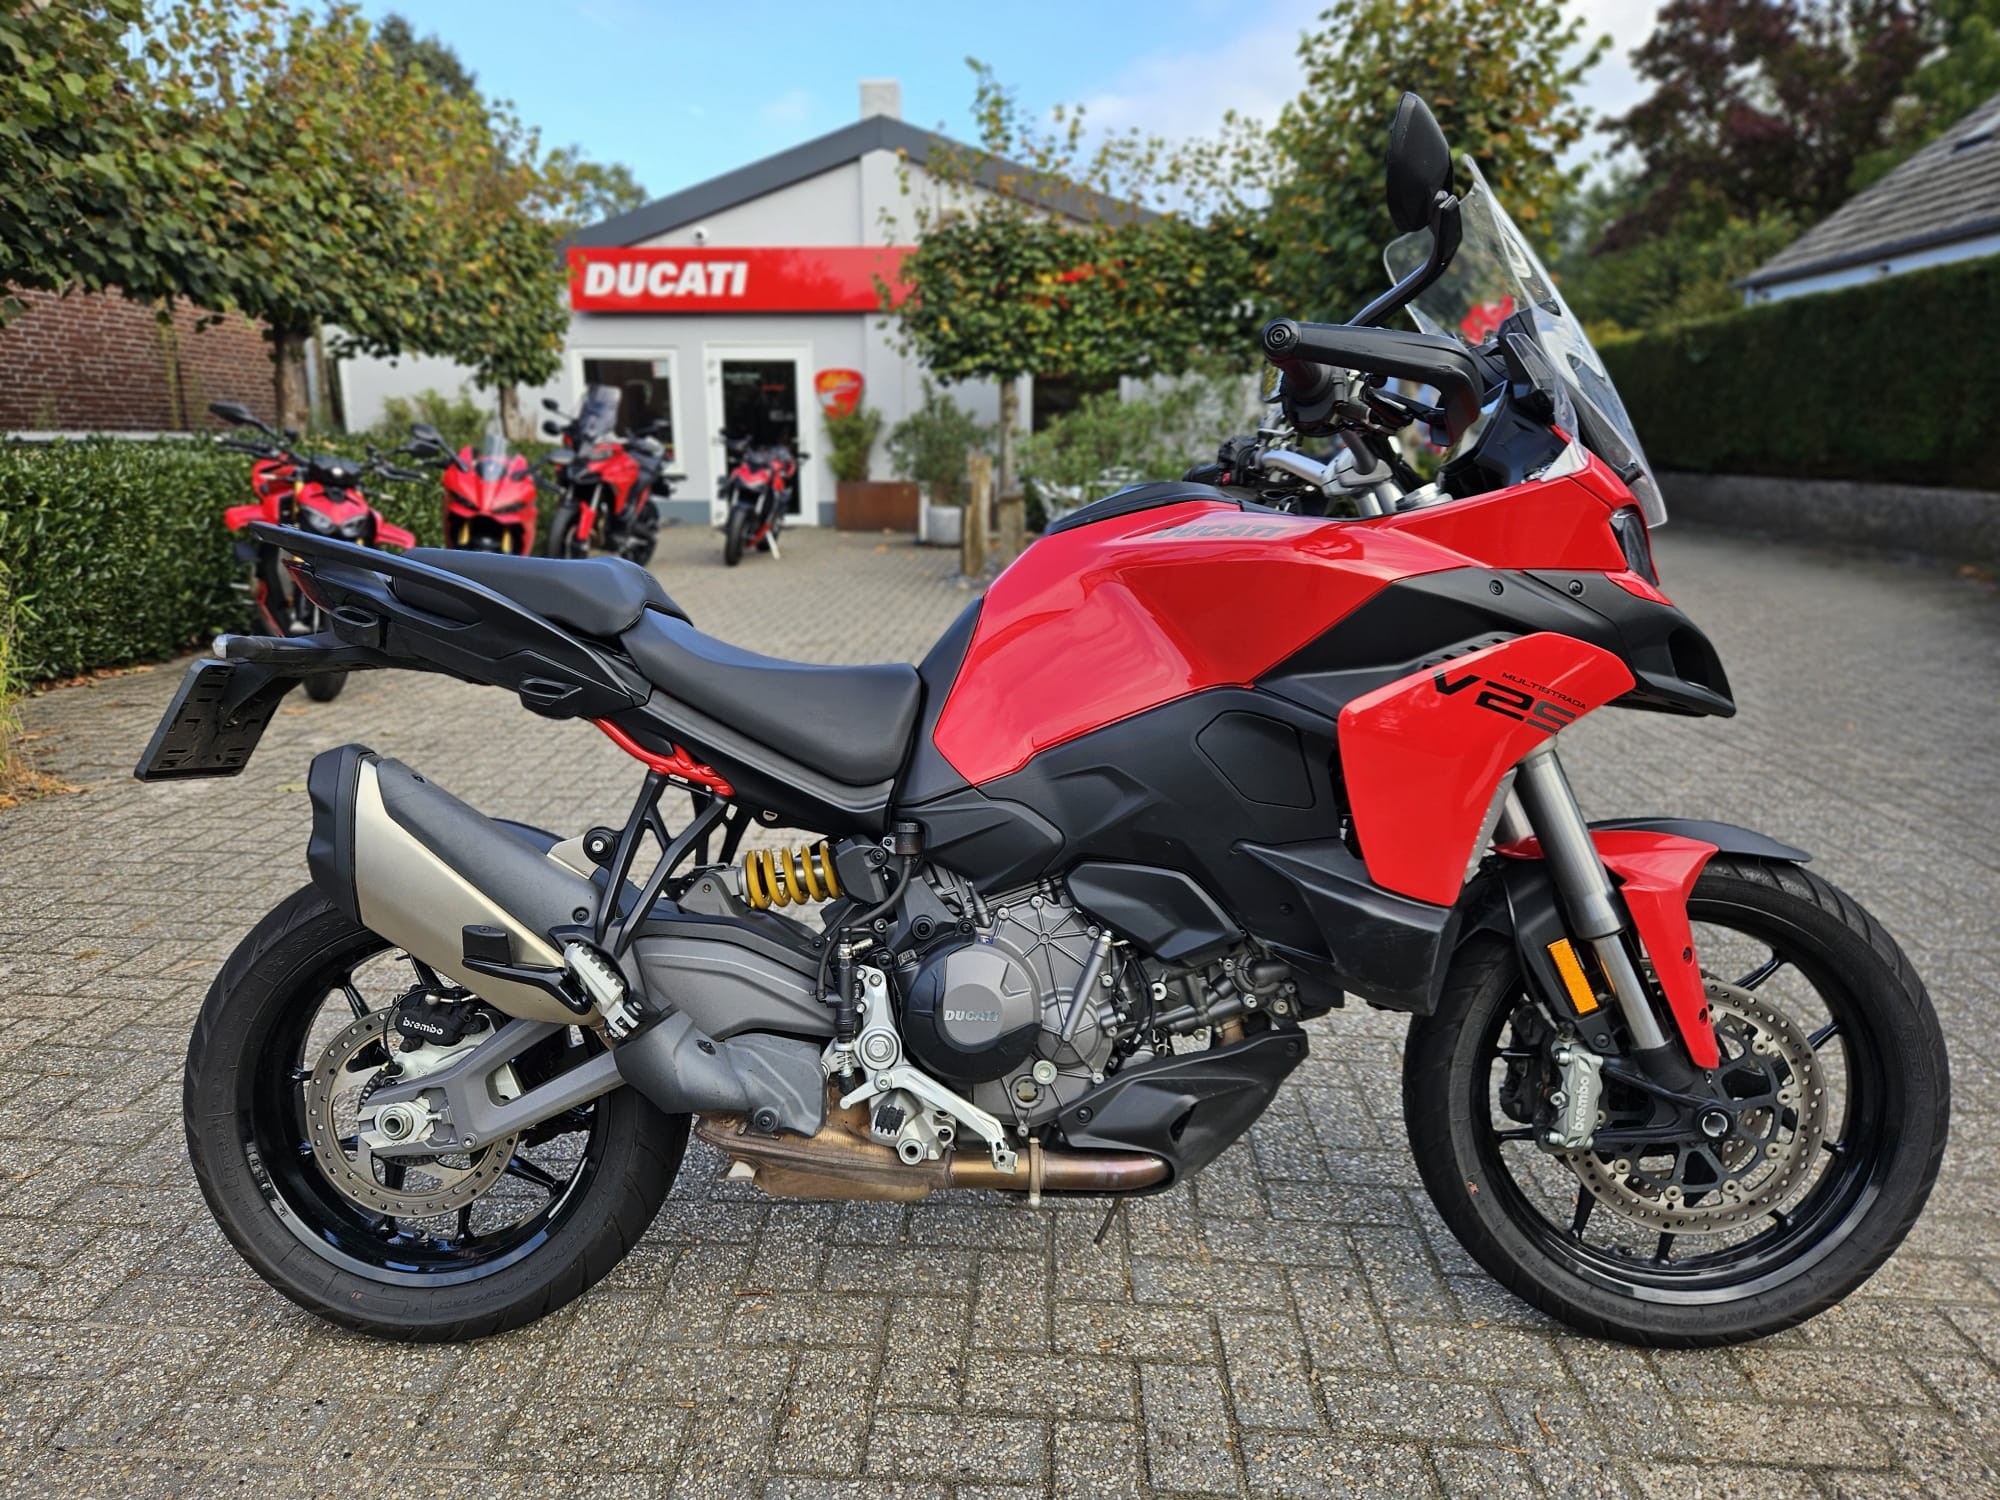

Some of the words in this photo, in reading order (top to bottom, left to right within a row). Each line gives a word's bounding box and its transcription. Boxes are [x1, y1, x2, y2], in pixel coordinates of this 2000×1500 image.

[584, 261, 748, 297] DUCATI
[1501, 672, 1586, 710] MULTISTRADA
[402, 1017, 443, 1035] brembo
[944, 1009, 1000, 1021] DUCATI
[1571, 1076, 1590, 1132] brembo
